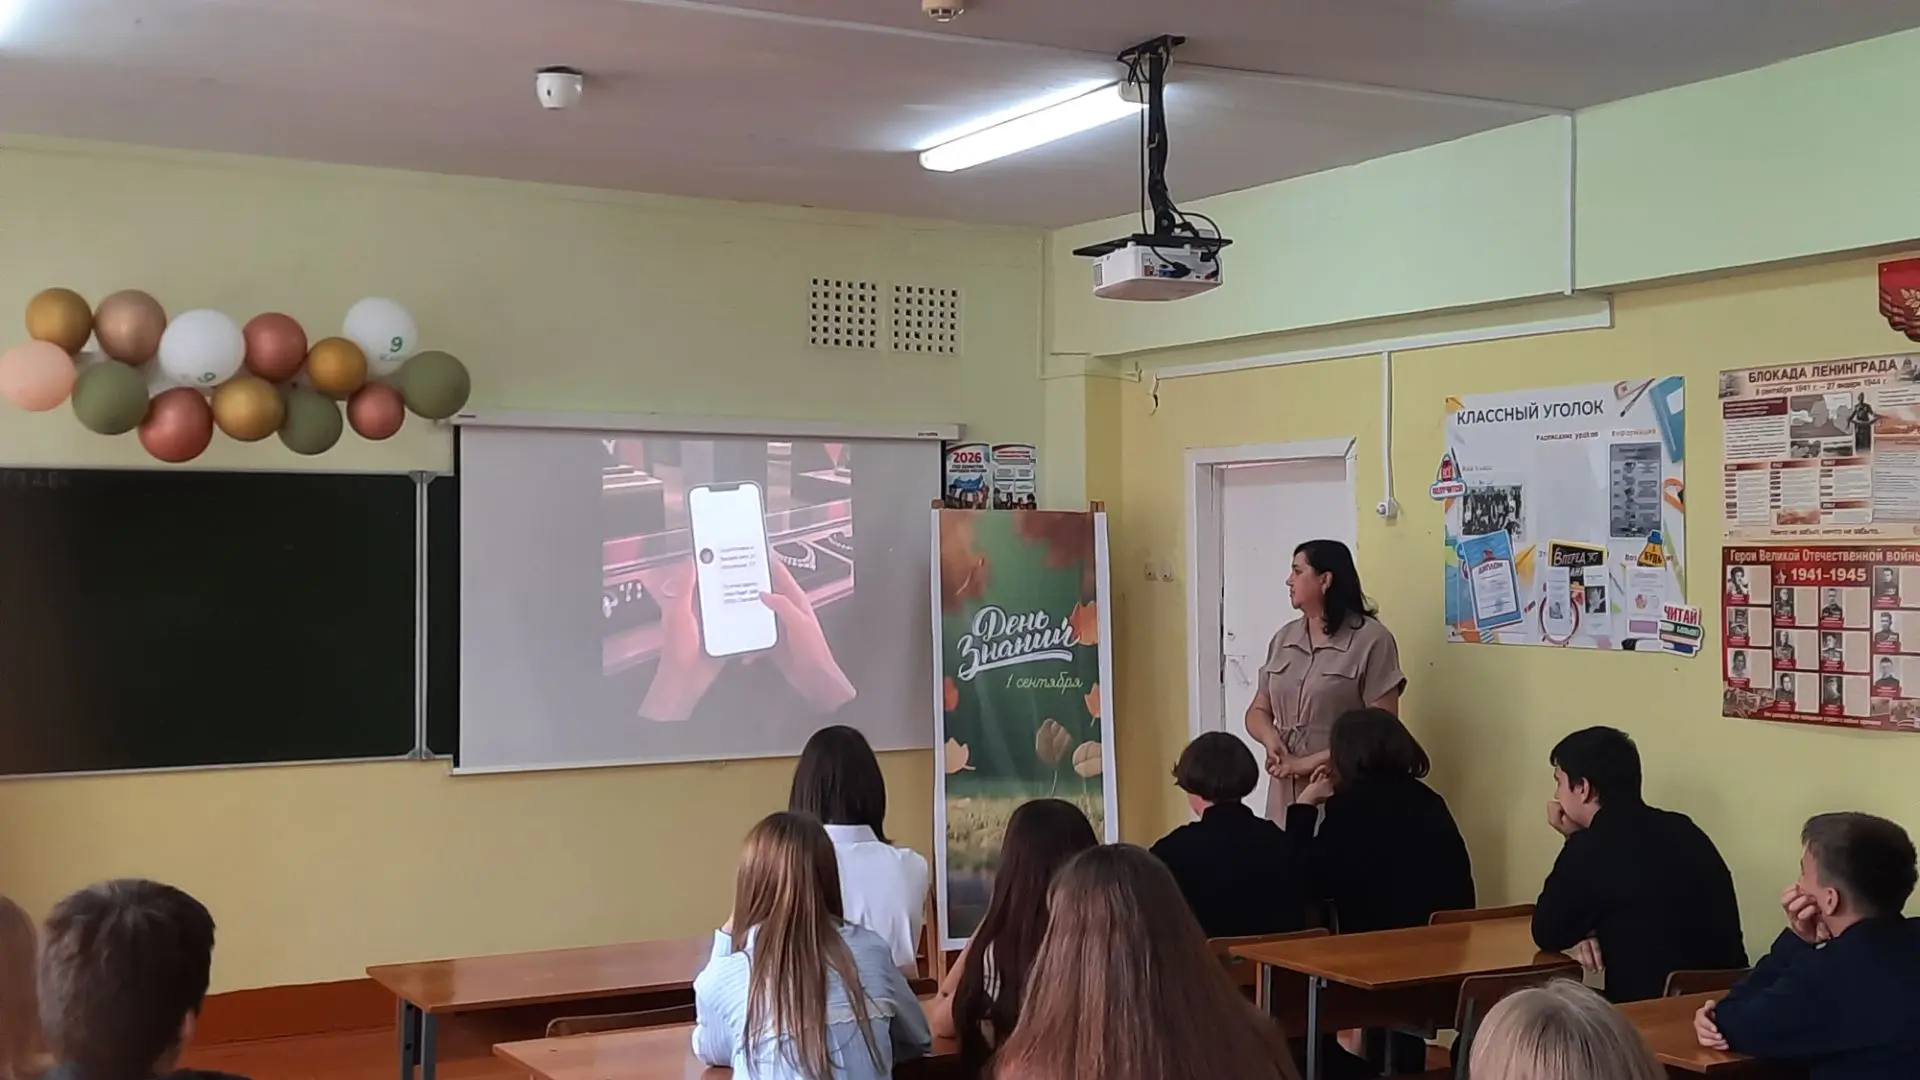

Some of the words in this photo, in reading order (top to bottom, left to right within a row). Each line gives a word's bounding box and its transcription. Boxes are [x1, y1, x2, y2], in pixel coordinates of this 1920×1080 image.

[390, 336, 403, 353] 9
[1748, 368, 1807, 383] БЛОКАДА
[1811, 359, 1898, 379] ЛЕНИНГРАДА
[1457, 402, 1539, 426] КЛАССНЫЙ
[1543, 399, 1604, 418] УГОЛОК
[953, 452, 982, 463] 2026
[1730, 549, 1757, 563] Герои
[1759, 549, 1800, 562] Великой
[1802, 548, 1883, 562] Отечественной
[972, 606, 1050, 641] День
[1663, 604, 1698, 625] ЧИТАЙ
[1006, 674, 1013, 688] 1
[1016, 672, 1084, 695] сентября
